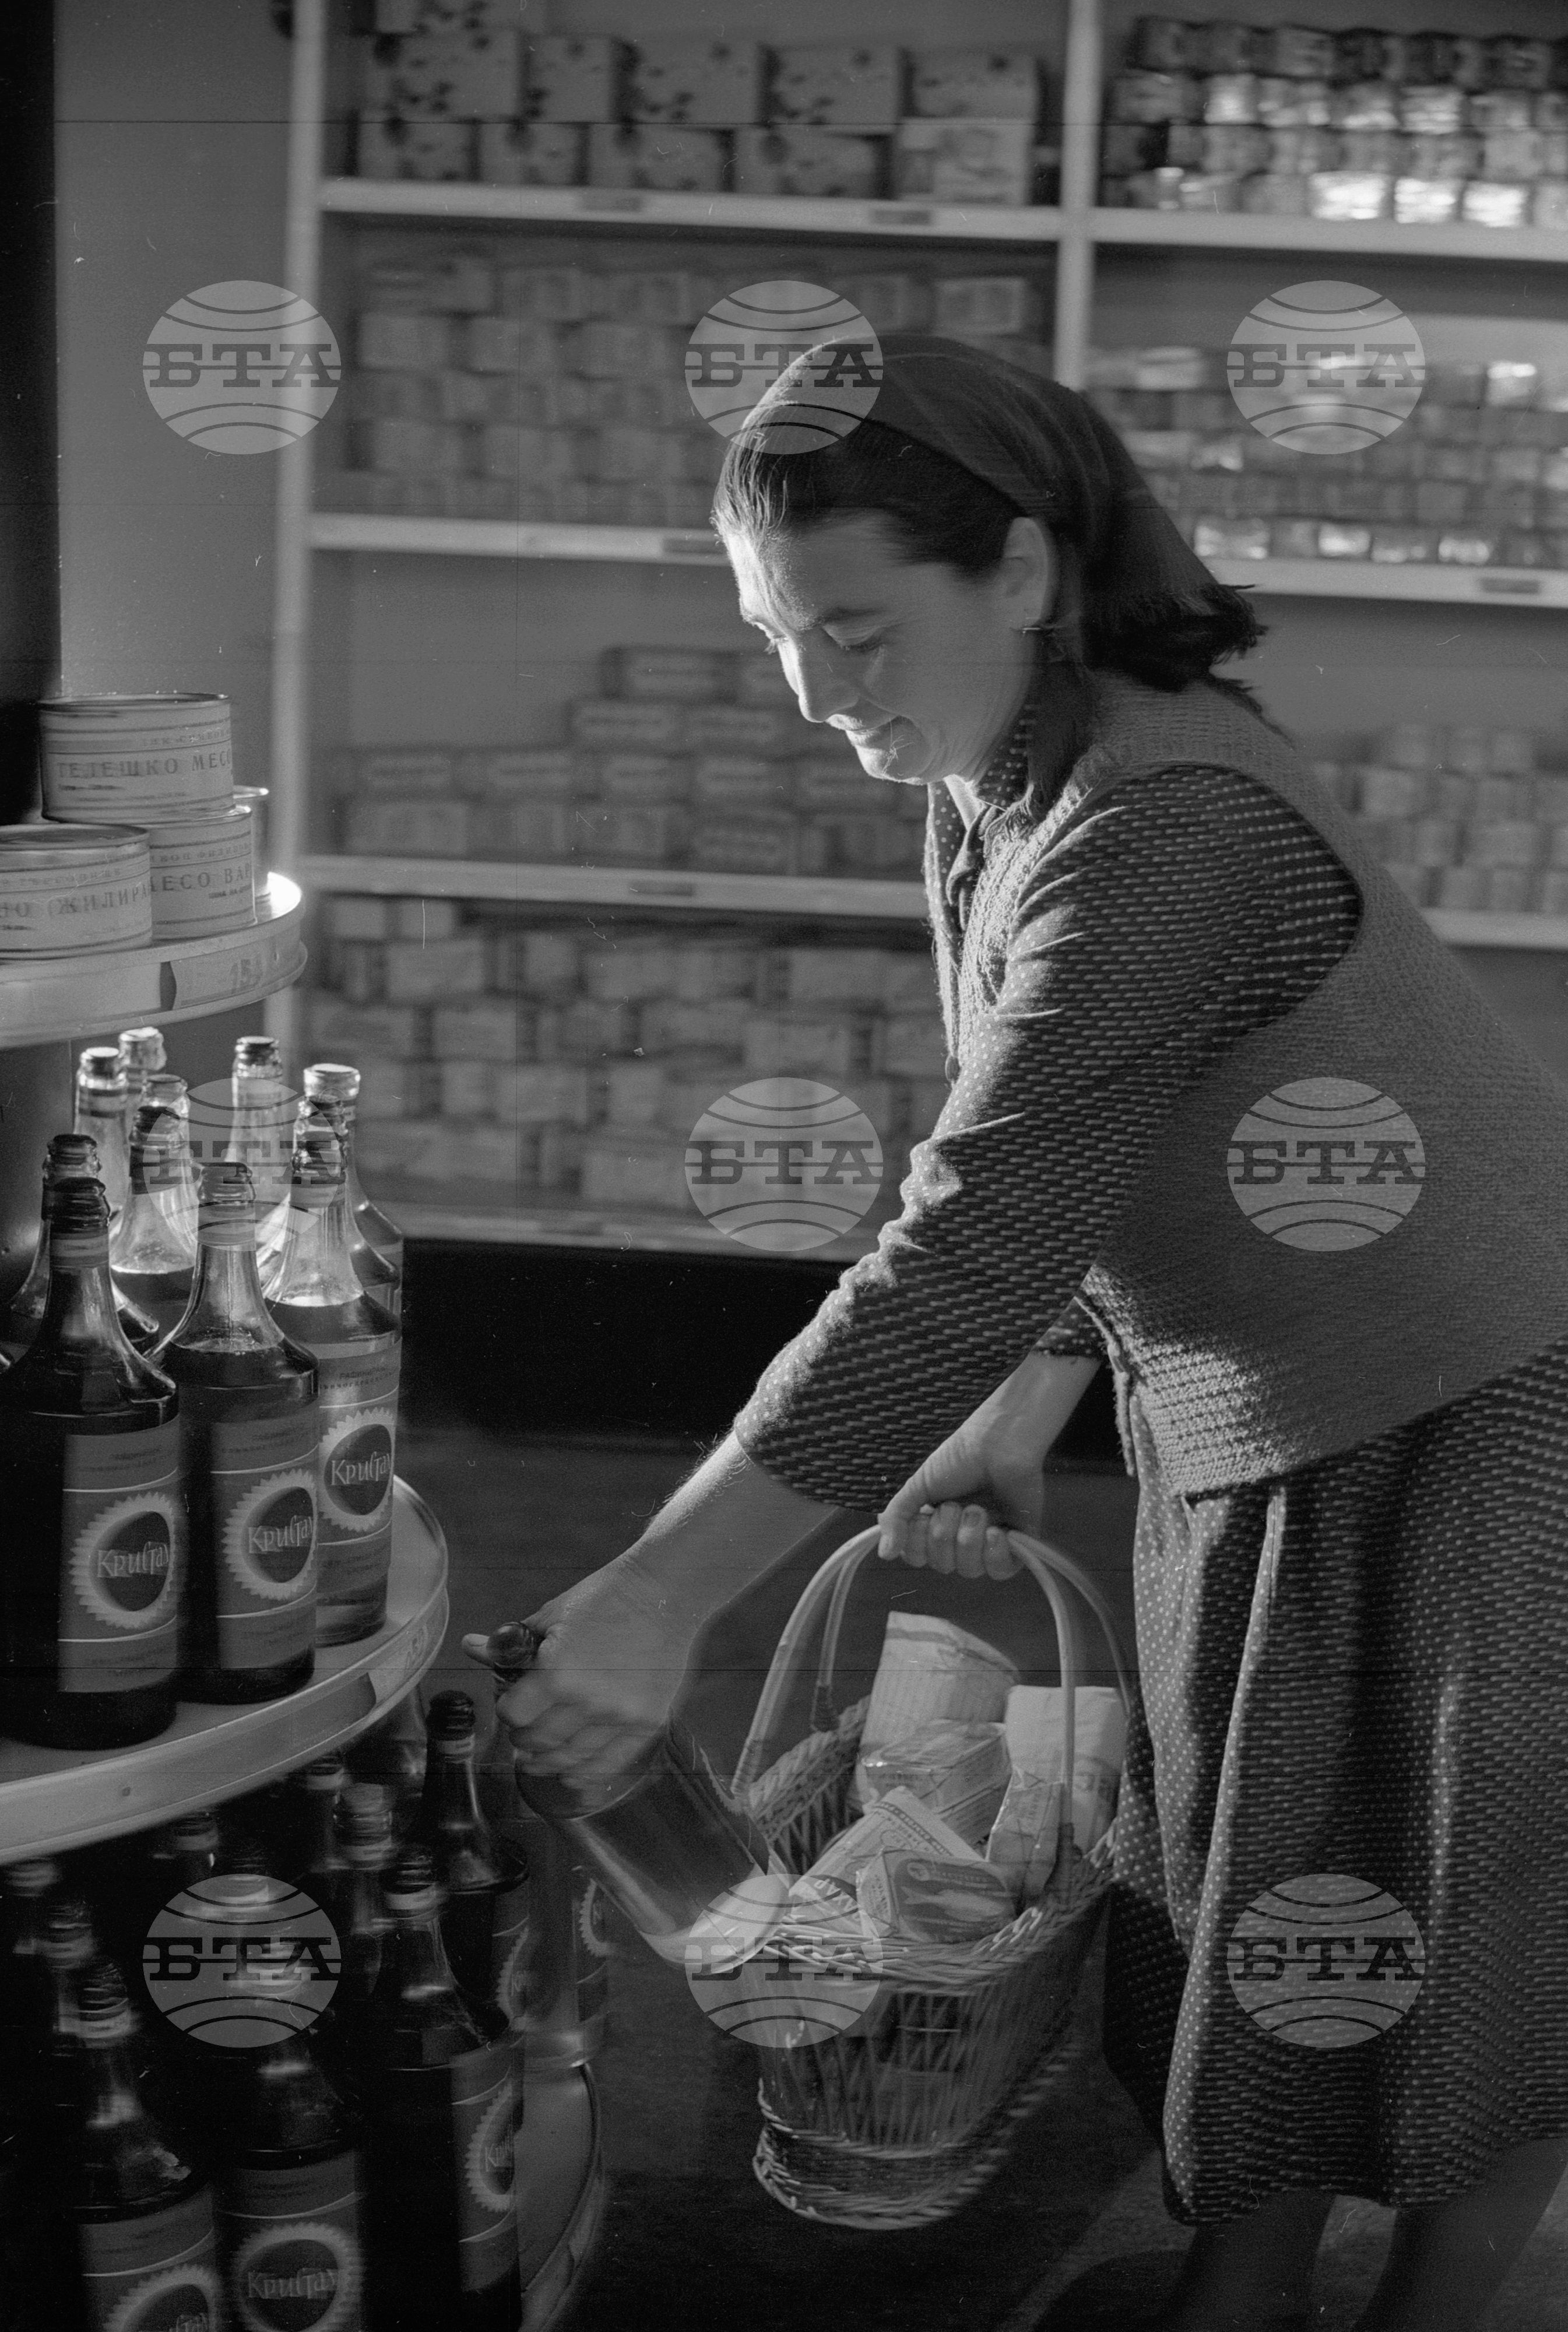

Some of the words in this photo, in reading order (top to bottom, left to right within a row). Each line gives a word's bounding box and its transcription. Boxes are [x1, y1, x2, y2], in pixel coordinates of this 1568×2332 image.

[59, 758, 178, 779] ТЕЛЕШКО
[224, 863, 252, 884] ВАР
[47, 883, 150, 919] (ЖИЛИРА
